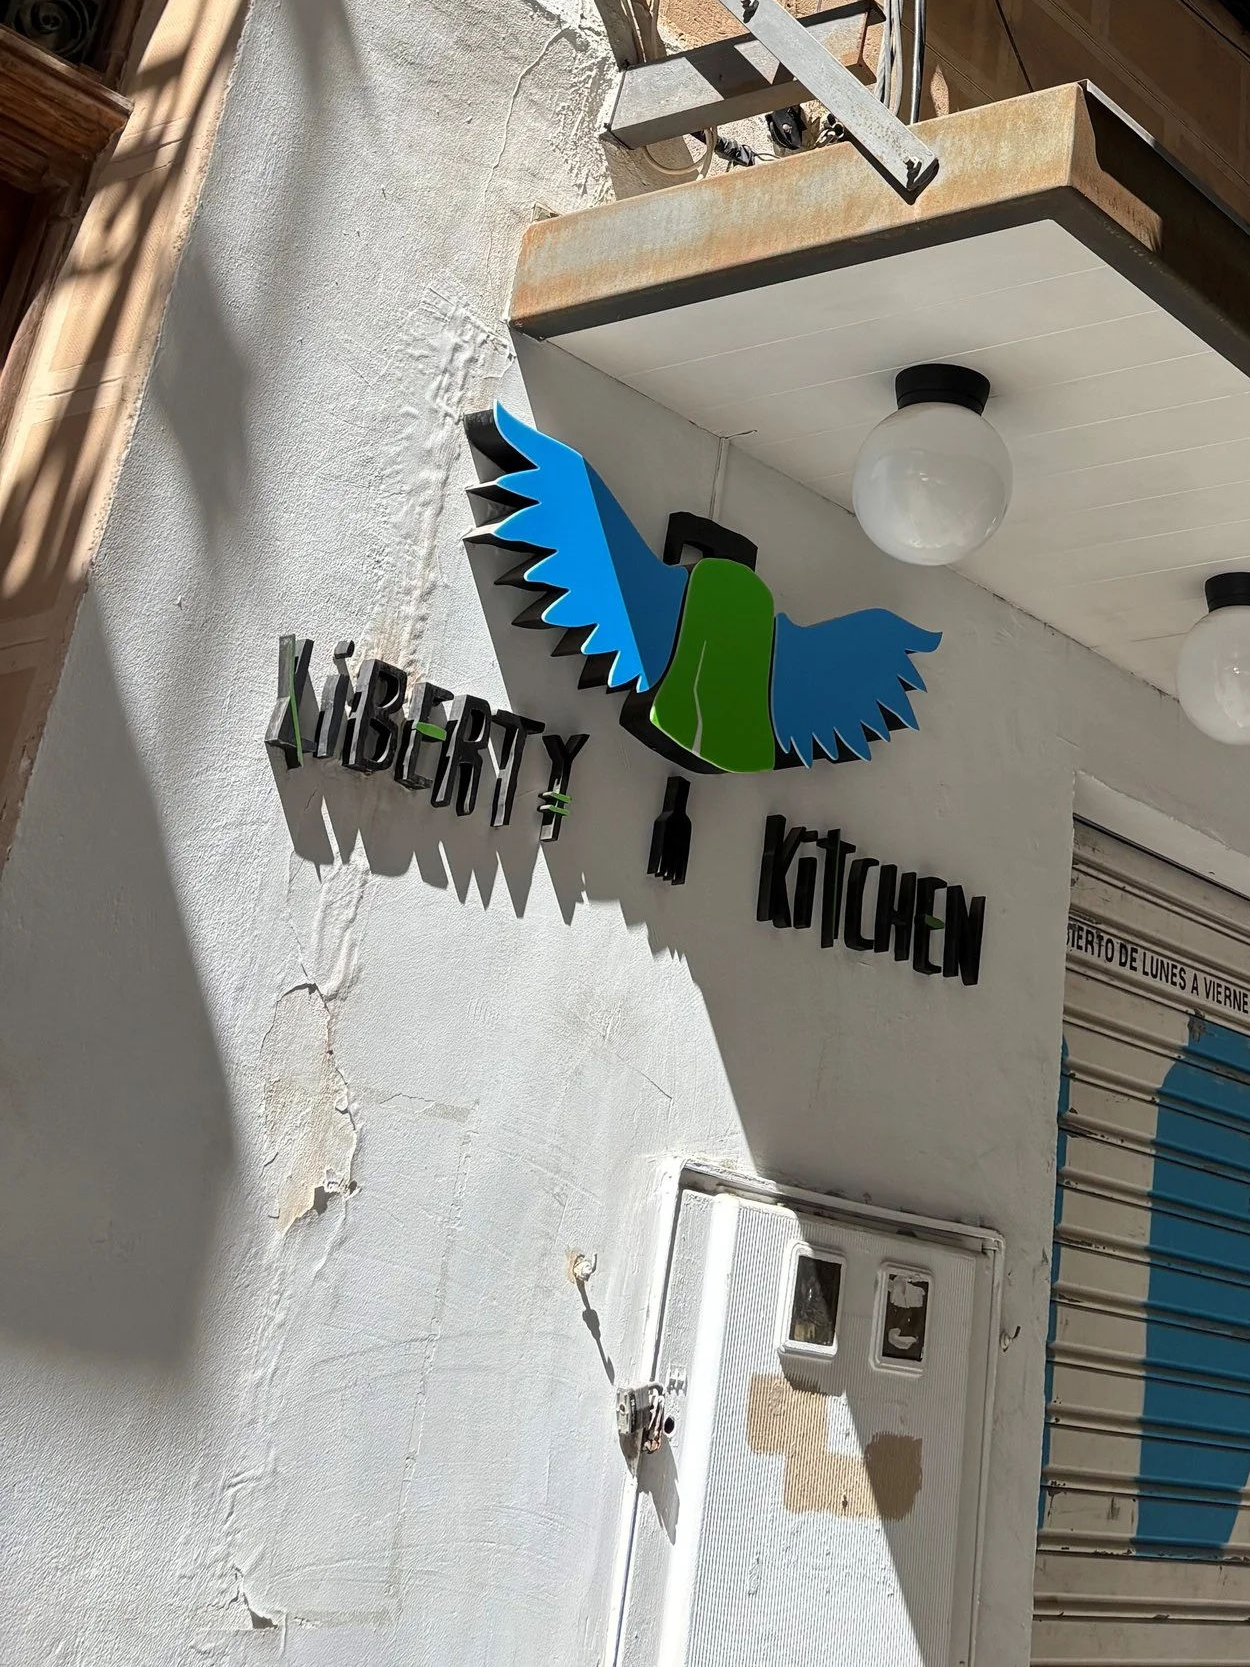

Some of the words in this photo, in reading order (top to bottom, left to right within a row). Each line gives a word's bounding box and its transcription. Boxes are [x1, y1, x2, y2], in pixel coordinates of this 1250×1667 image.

[1119, 943, 1138, 972] DE
[1142, 951, 1187, 990] LUNES
[1191, 973, 1199, 996] A
